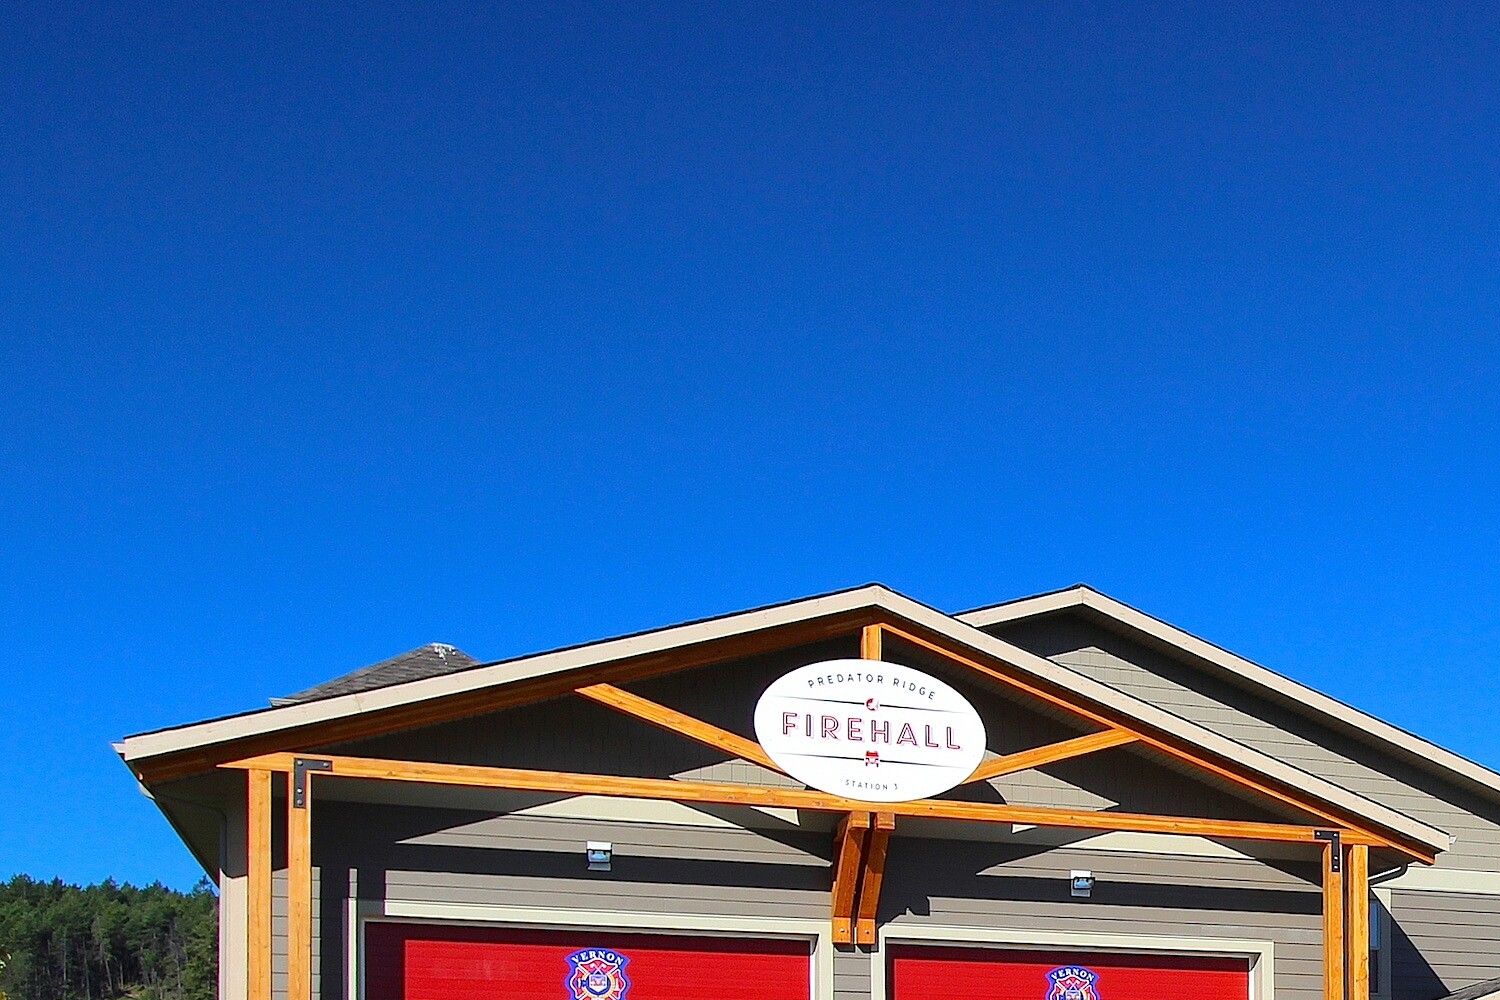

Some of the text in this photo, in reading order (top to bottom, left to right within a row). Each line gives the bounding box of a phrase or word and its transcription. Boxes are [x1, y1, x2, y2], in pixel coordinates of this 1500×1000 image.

[808, 673, 936, 700] PREDATOR RIDGE
[782, 711, 963, 750] FIREHALL
[845, 779, 888, 790] STATION
[571, 950, 624, 966] VERNON
[1051, 968, 1095, 982] VERNON
